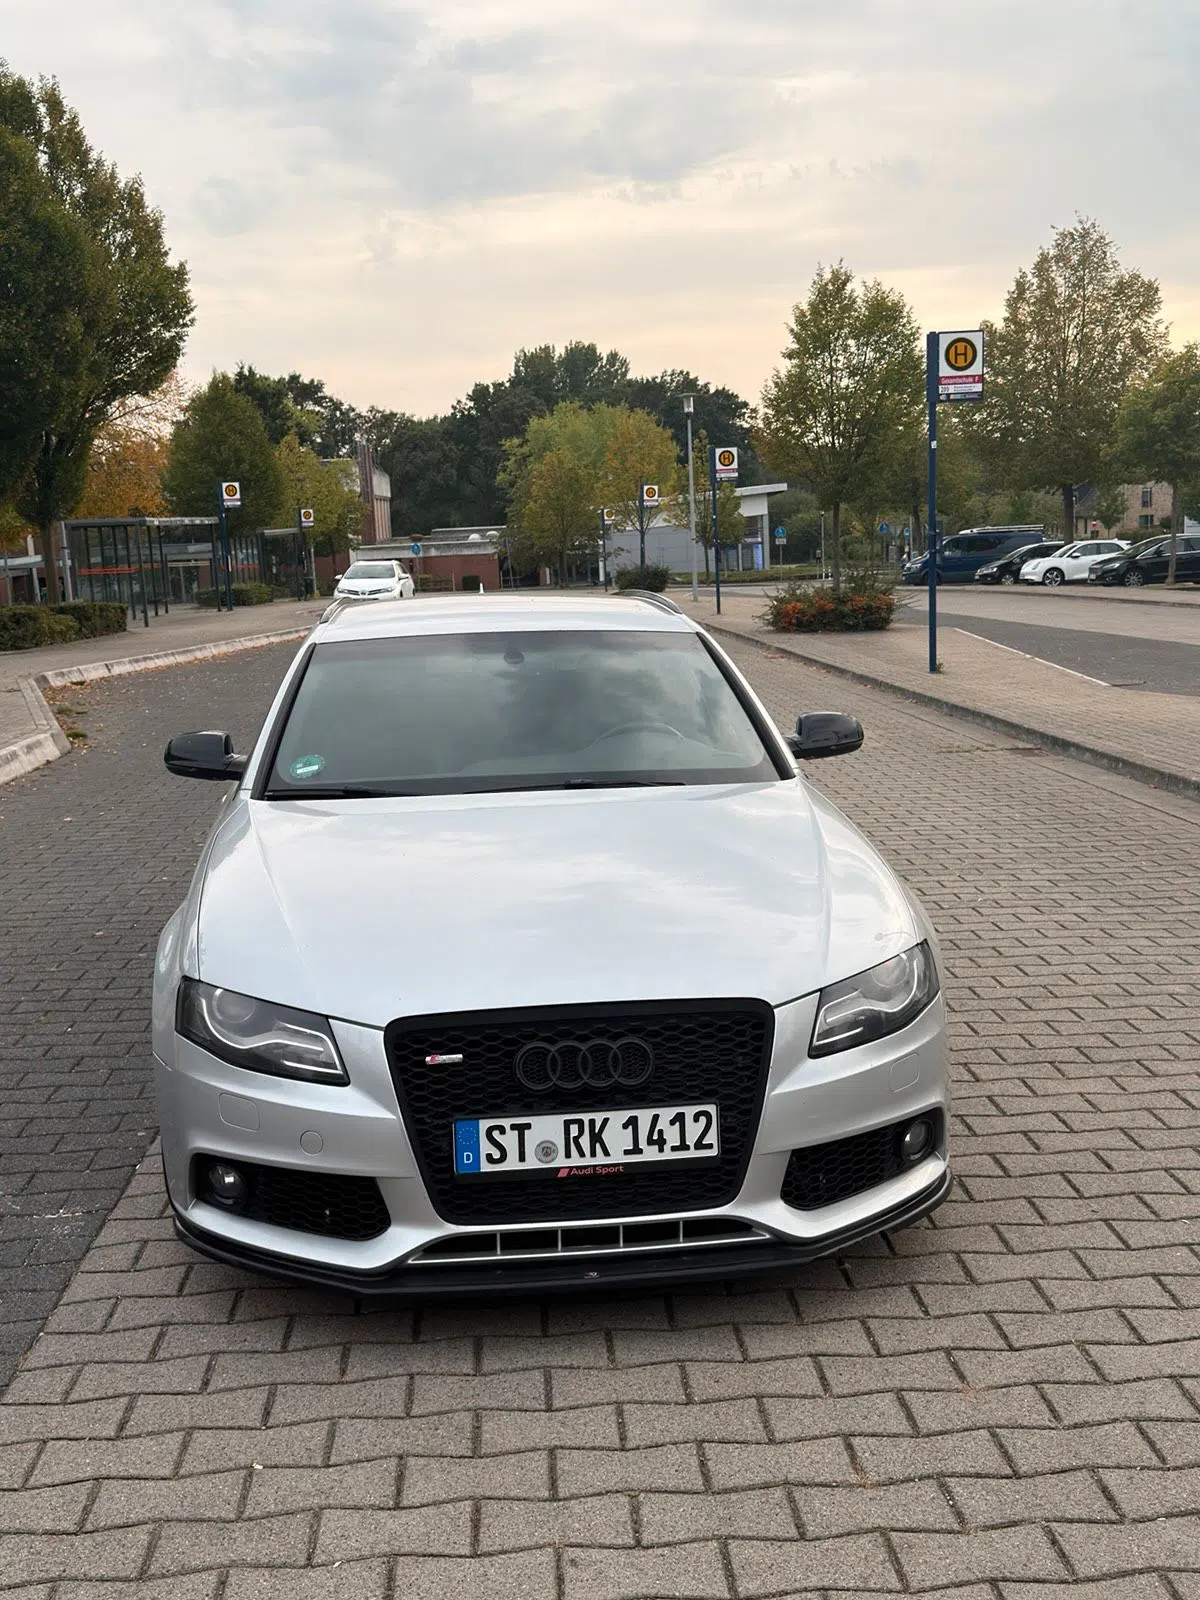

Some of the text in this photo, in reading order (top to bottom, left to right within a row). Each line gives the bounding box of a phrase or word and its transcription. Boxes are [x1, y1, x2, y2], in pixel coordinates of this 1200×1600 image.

[954, 344, 968, 364] H
[485, 1109, 714, 1165] ST RK 1412
[463, 1151, 473, 1164] D
[570, 1164, 625, 1176] Audi Sport
